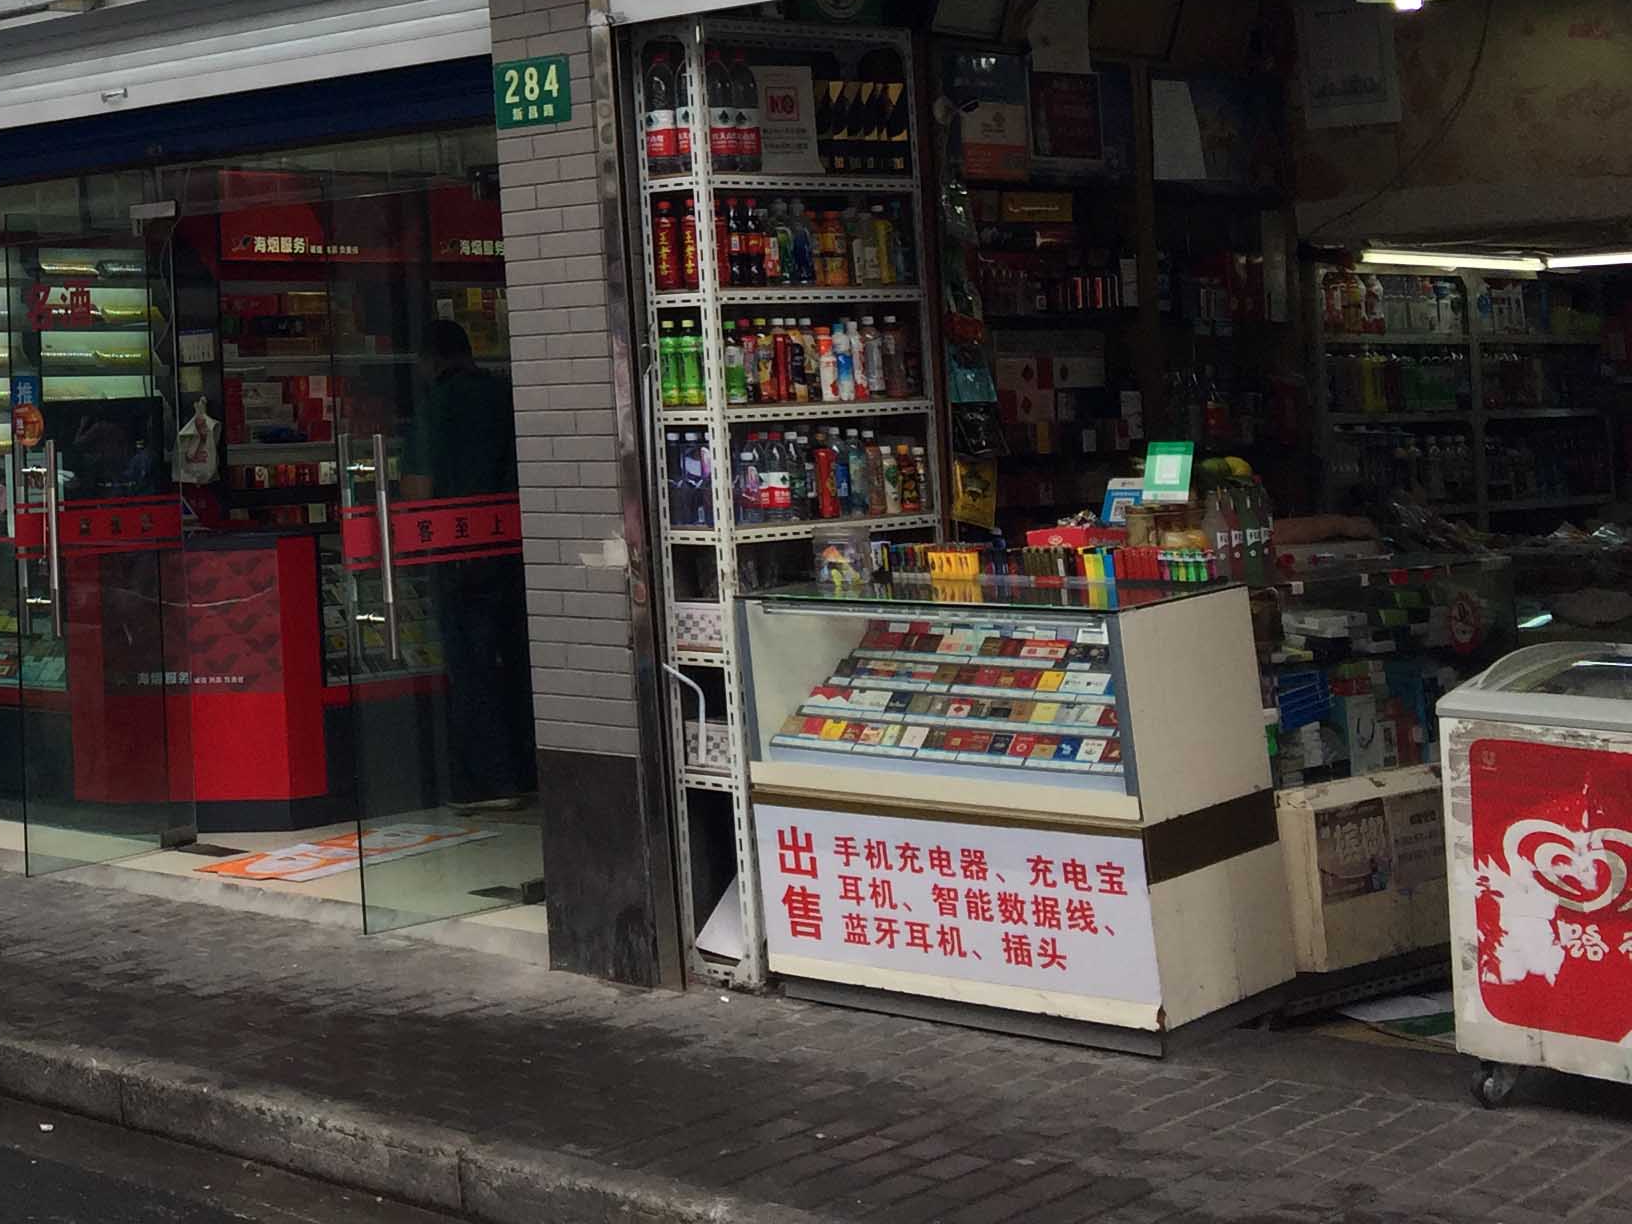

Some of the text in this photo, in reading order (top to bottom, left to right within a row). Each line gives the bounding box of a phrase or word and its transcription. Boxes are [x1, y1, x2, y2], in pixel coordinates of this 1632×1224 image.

[504, 64, 560, 104] 284
[254, 236, 305, 254] 海烟服务
[26, 280, 95, 332] 名酒
[392, 514, 505, 543] 客至上
[776, 825, 825, 941] 出售
[833, 836, 1128, 896] 手机充电器、充电宝
[837, 875, 1119, 937] 耳机、智能数据线、
[842, 913, 1068, 972] 蓝牙耳机、插头
